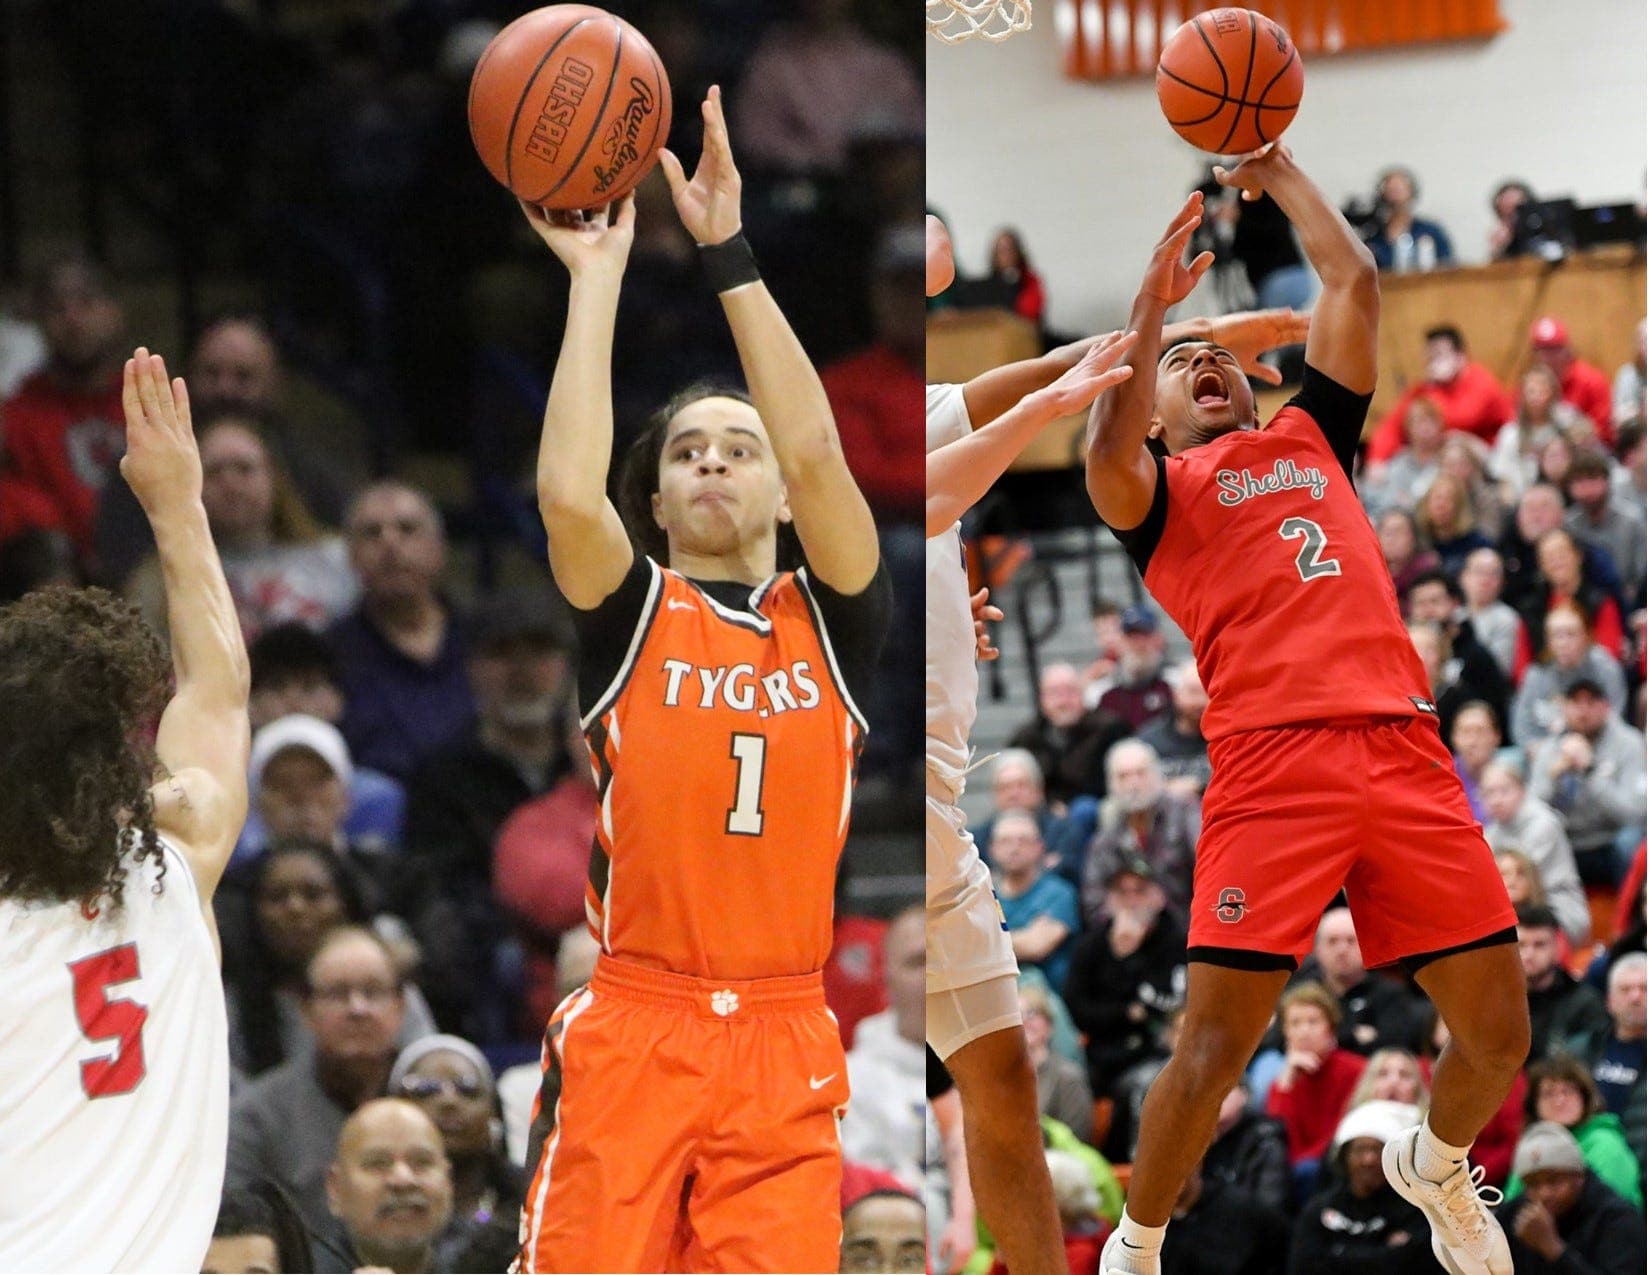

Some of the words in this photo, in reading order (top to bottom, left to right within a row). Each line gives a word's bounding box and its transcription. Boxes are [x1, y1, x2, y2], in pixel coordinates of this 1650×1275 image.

[525, 56, 594, 165] OHSAA
[593, 76, 655, 194] Rawlings
[1216, 458, 1328, 506] Shelby
[1277, 516, 1342, 583] 2
[661, 657, 820, 718] TYGRS
[724, 731, 767, 837] 1
[66, 940, 149, 1100] 5
